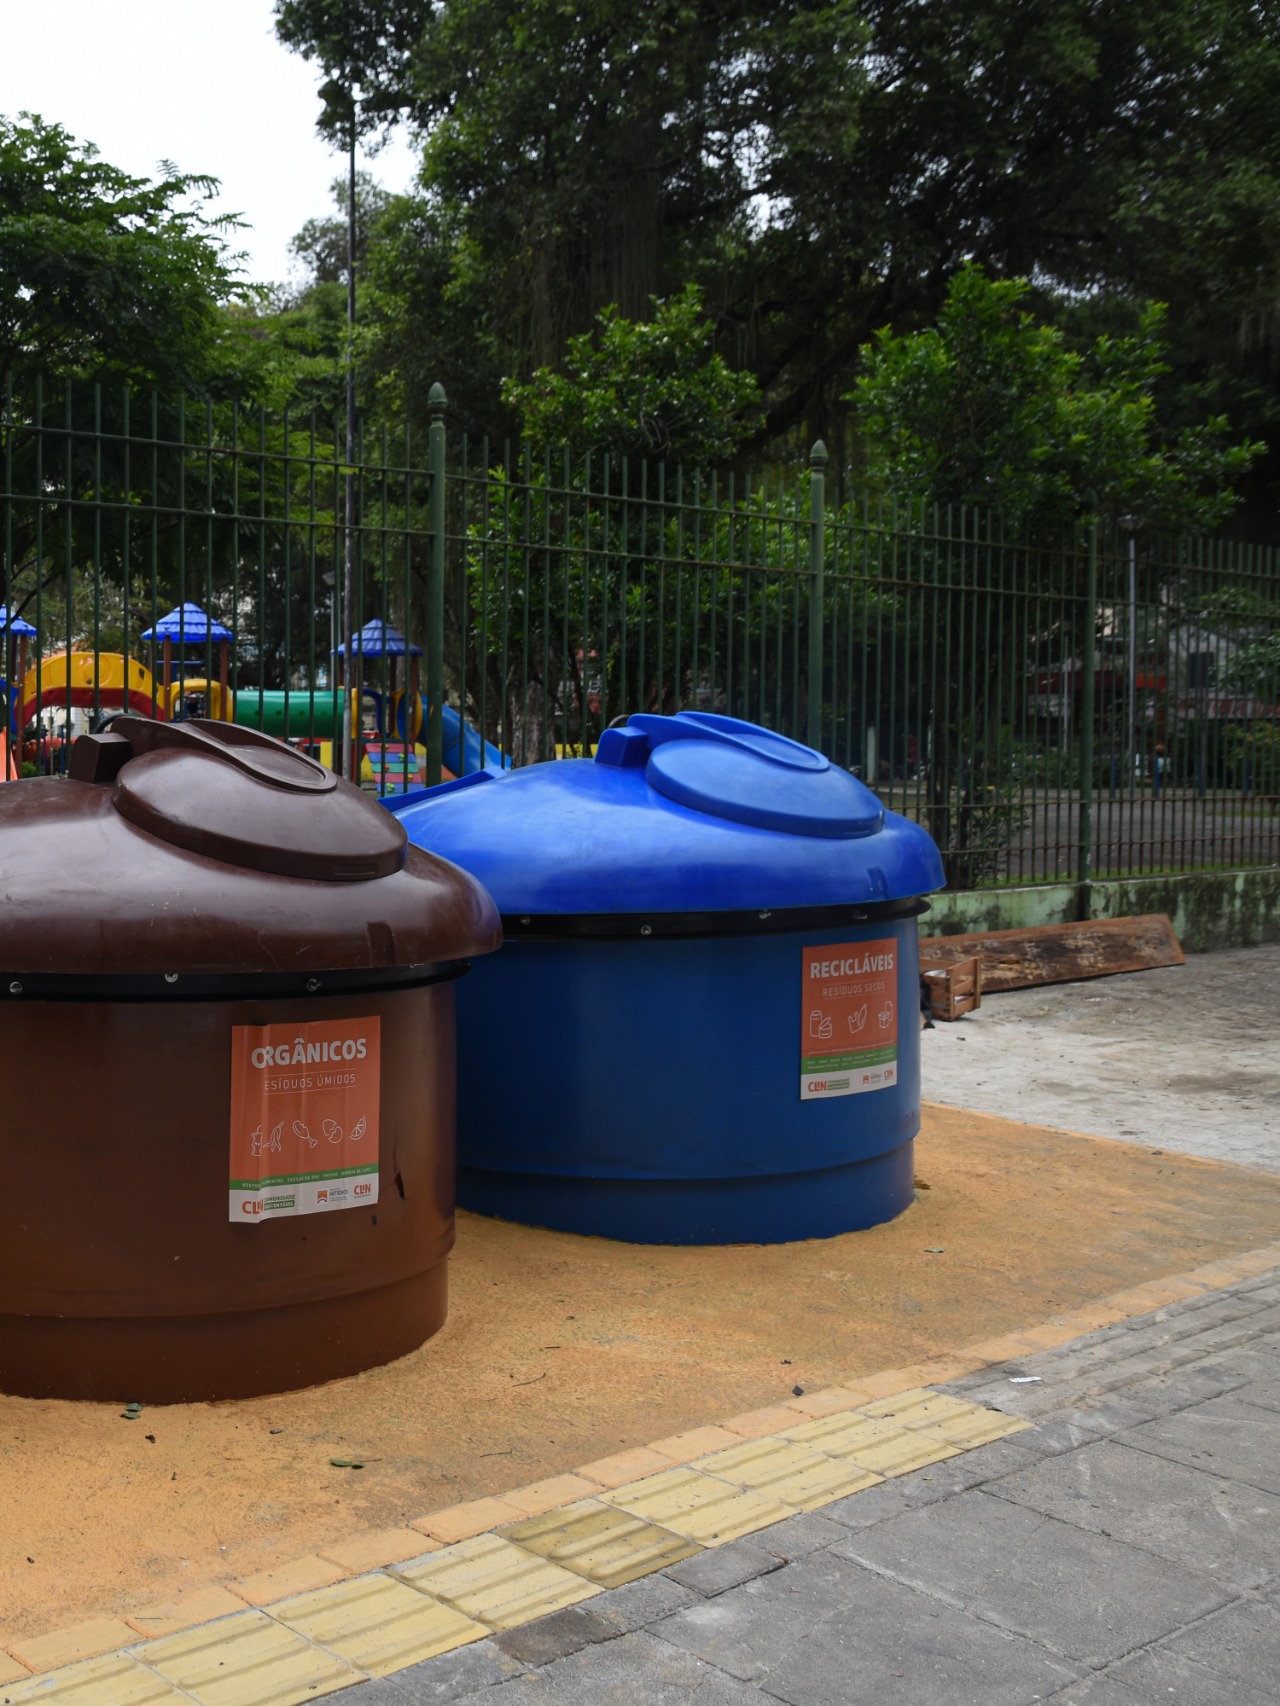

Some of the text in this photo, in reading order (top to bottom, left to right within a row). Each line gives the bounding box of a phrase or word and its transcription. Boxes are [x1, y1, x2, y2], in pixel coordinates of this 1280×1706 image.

[810, 952, 894, 979] RECICLÁVEIS
[822, 981, 886, 997] RESÍDUOS SECOS
[251, 1037, 367, 1069] ORGÂNICOS
[264, 1073, 356, 1091] ESÍDUOS ÚMIDOS
[353, 1183, 372, 1196] CLIN
